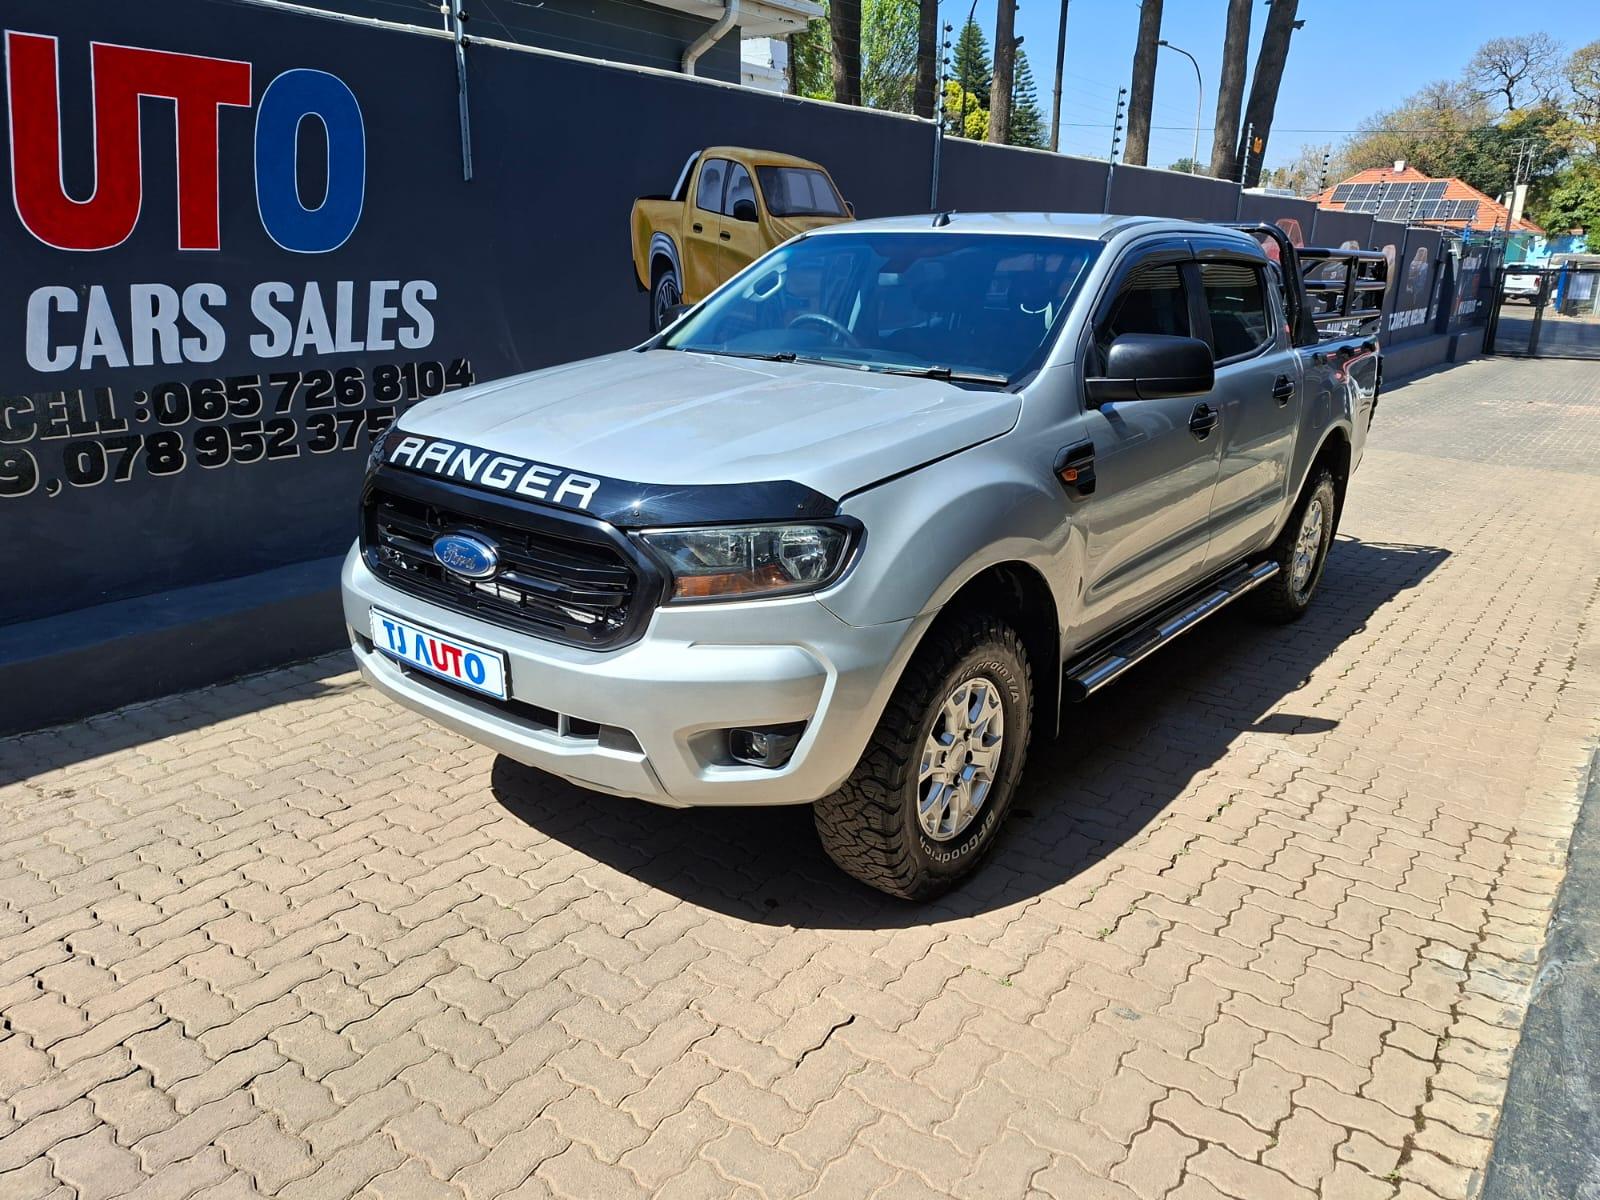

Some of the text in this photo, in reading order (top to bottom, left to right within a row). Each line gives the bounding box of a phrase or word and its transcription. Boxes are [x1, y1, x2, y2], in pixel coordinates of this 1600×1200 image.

[4, 29, 367, 254] UTO
[25, 279, 438, 373] CARS SALES
[268, 366, 367, 414] 726
[372, 357, 476, 403] 8104
[193, 417, 301, 470] 952
[389, 437, 601, 510] RANGER
[443, 542, 477, 570] Ford
[382, 619, 486, 685] TJ AUTO
[919, 809, 996, 864] BFGoodrich
